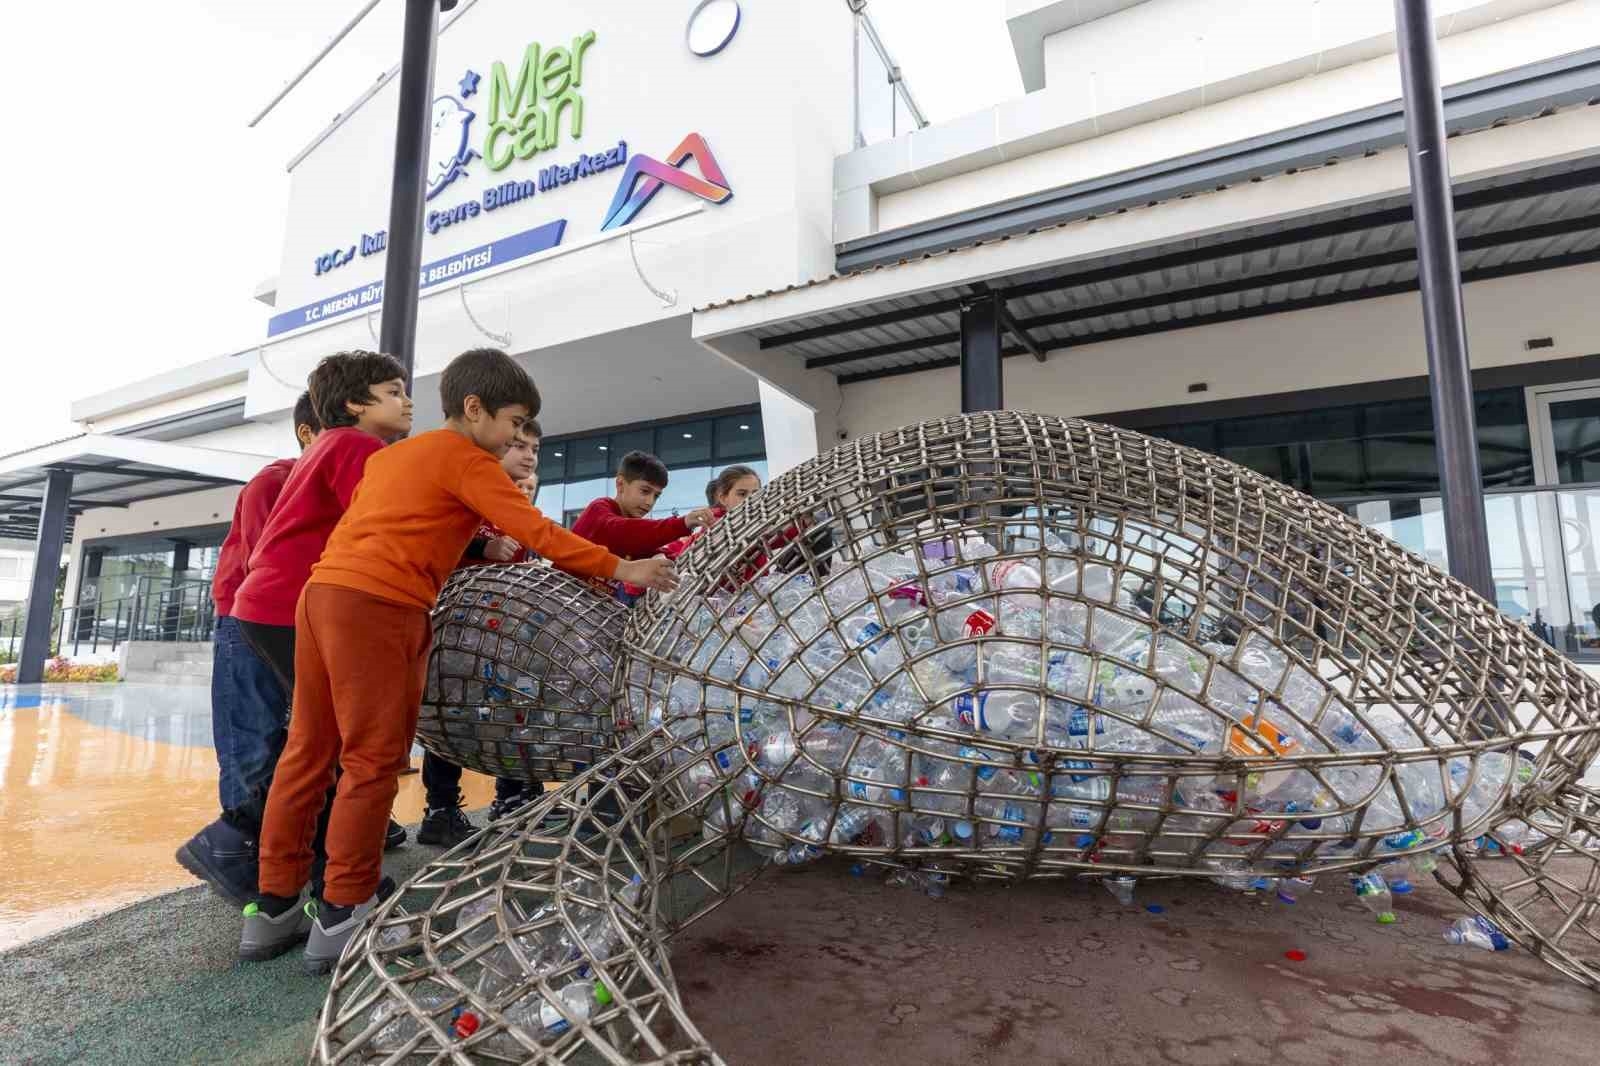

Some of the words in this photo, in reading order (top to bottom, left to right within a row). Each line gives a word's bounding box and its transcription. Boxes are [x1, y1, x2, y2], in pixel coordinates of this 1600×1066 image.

[488, 30, 596, 126] Mer
[483, 90, 583, 172] can
[426, 200, 481, 235] Çevre
[483, 181, 535, 212] Bilim
[538, 140, 627, 192] Merkezi
[305, 309, 321, 322] T.C.
[321, 292, 359, 318] MERSİN
[428, 245, 493, 283] BELEDİYESİ
